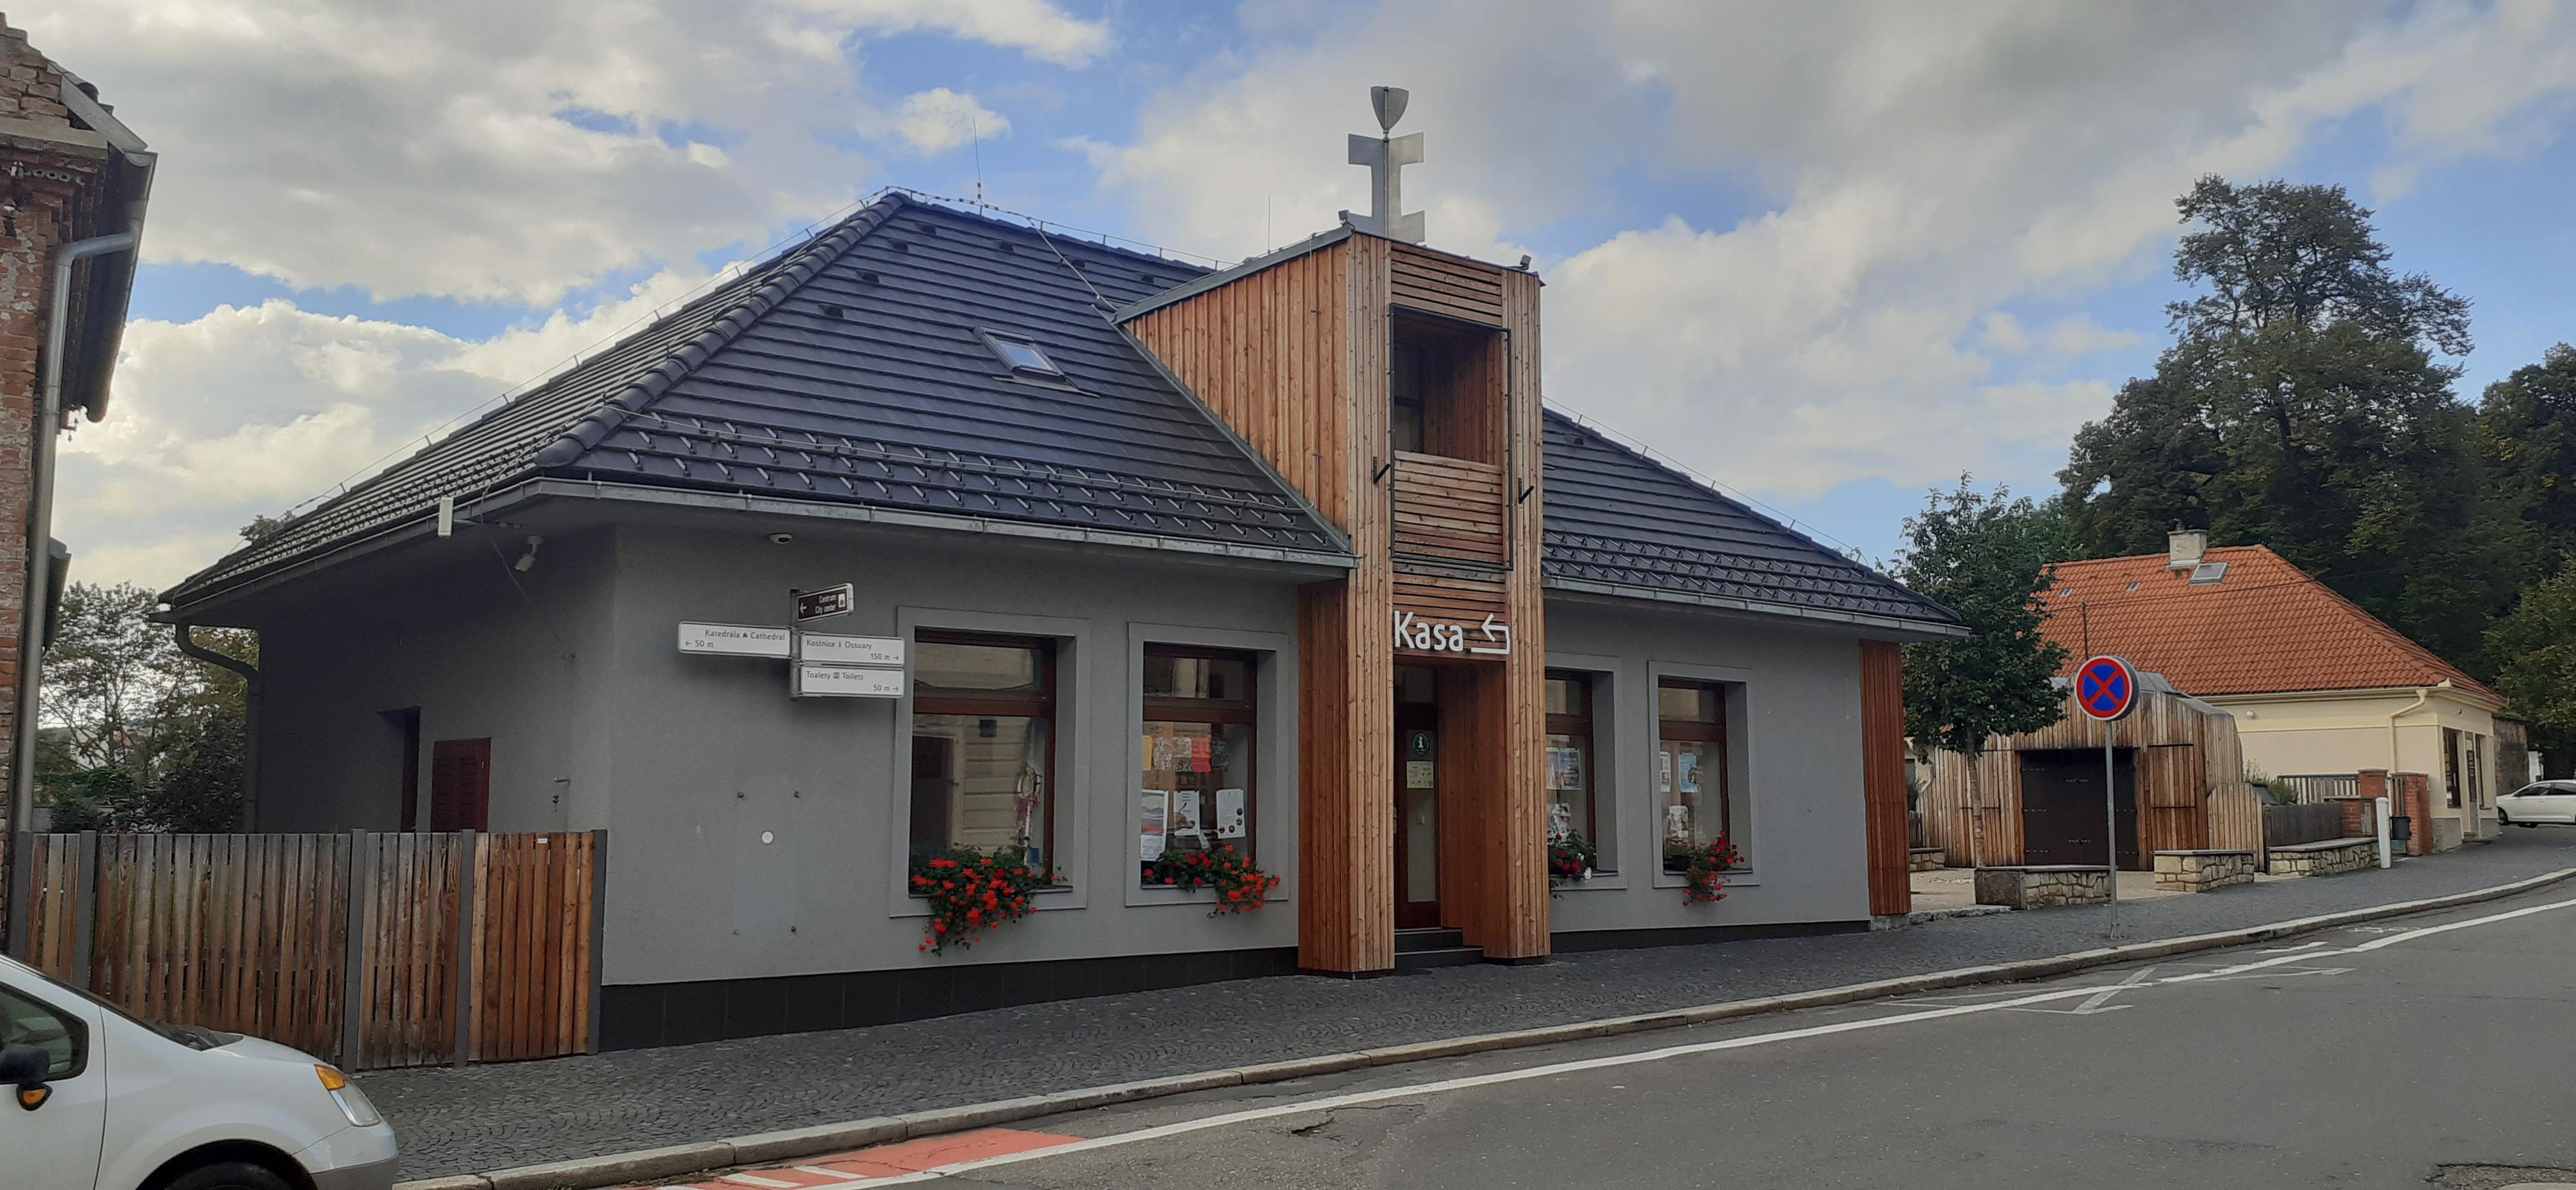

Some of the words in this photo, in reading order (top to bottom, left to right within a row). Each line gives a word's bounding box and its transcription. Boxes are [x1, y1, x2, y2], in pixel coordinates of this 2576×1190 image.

[705, 629, 740, 638] Katedrála
[750, 632, 785, 641] Cathedral
[1394, 610, 1464, 652] Kasa
[806, 639, 835, 647] Kostnice
[844, 641, 873, 650] Ossuary
[806, 671, 831, 680] Toalety
